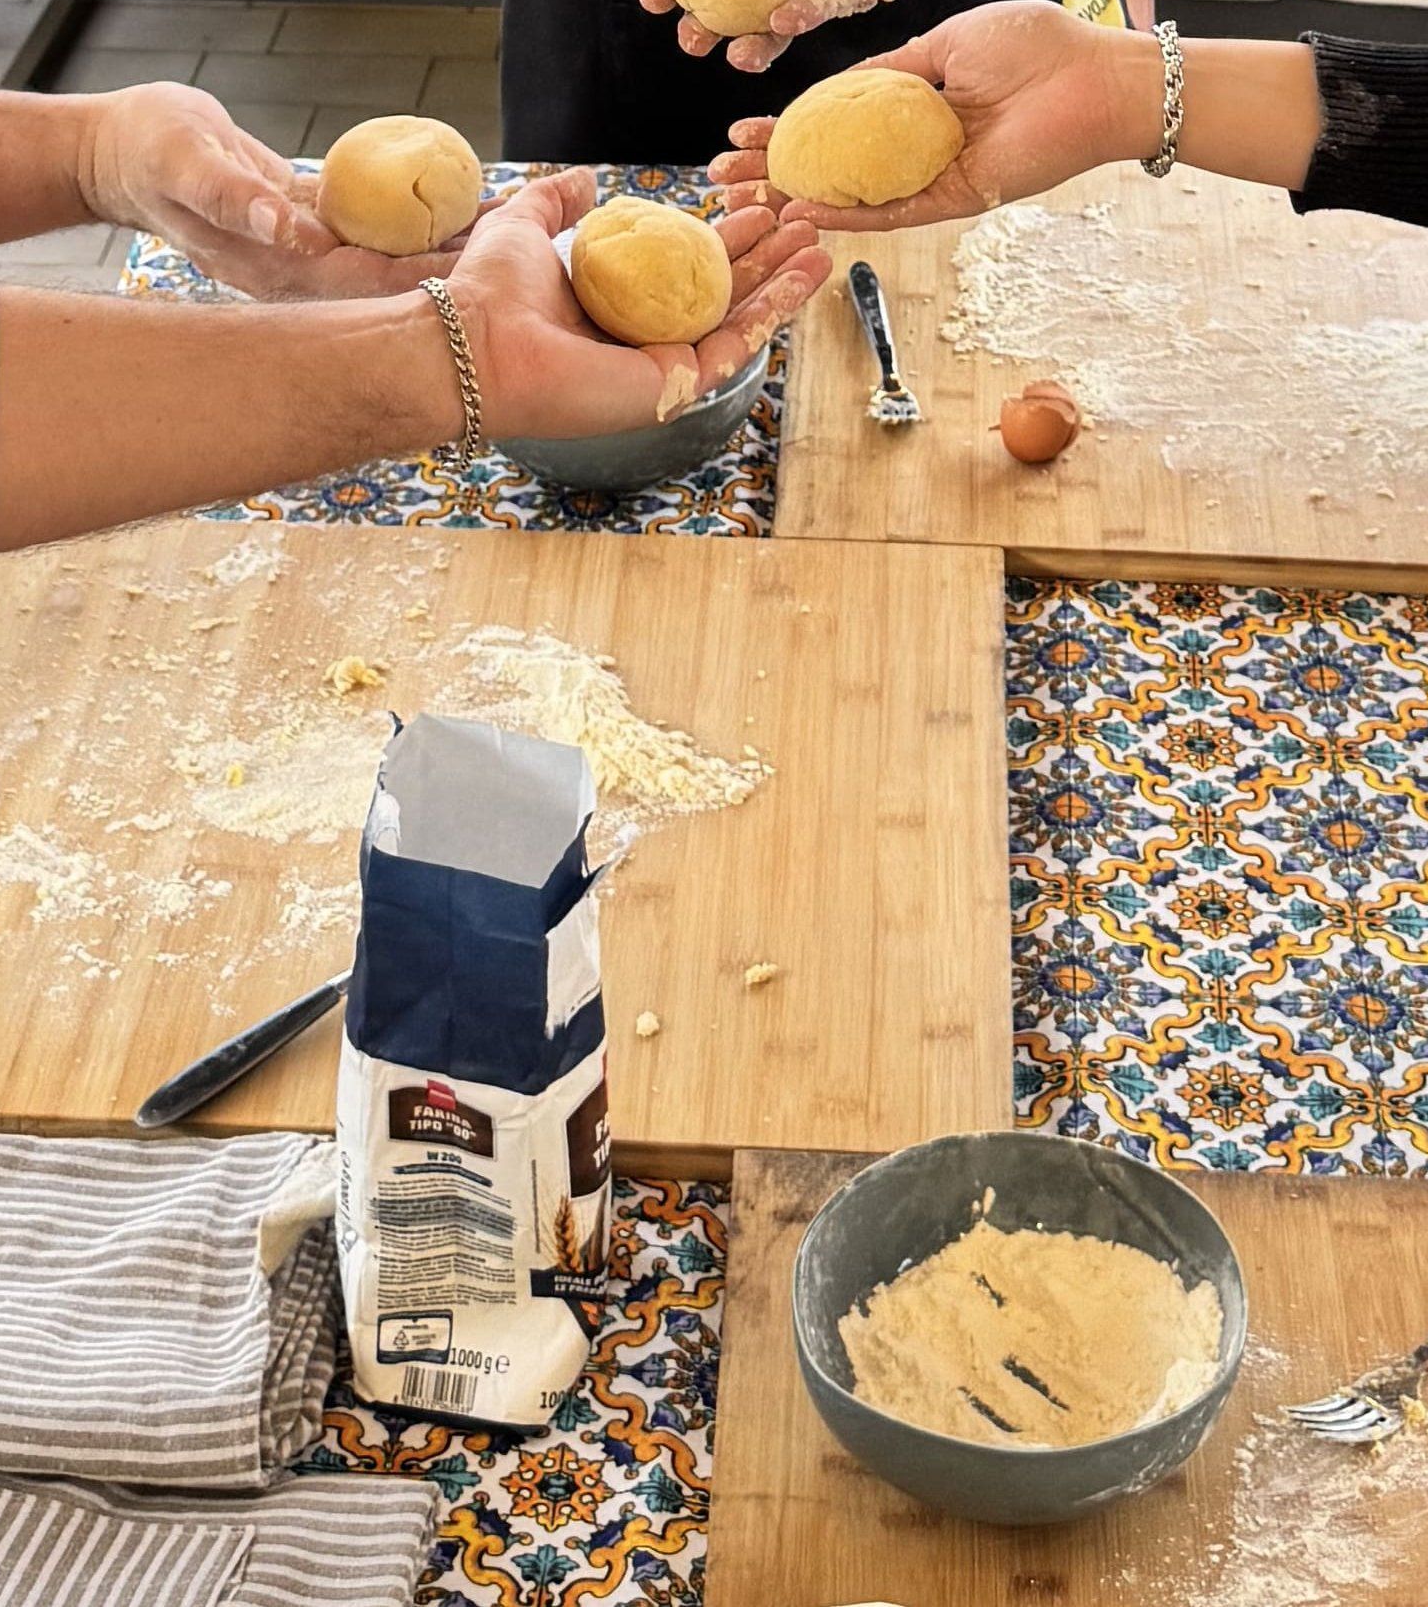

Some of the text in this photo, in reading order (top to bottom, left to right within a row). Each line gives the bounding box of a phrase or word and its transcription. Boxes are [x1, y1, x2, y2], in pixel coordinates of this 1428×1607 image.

[409, 1119, 443, 1132] TIPO
[450, 1347, 482, 1369] 1000
[484, 1356, 493, 1375] g
